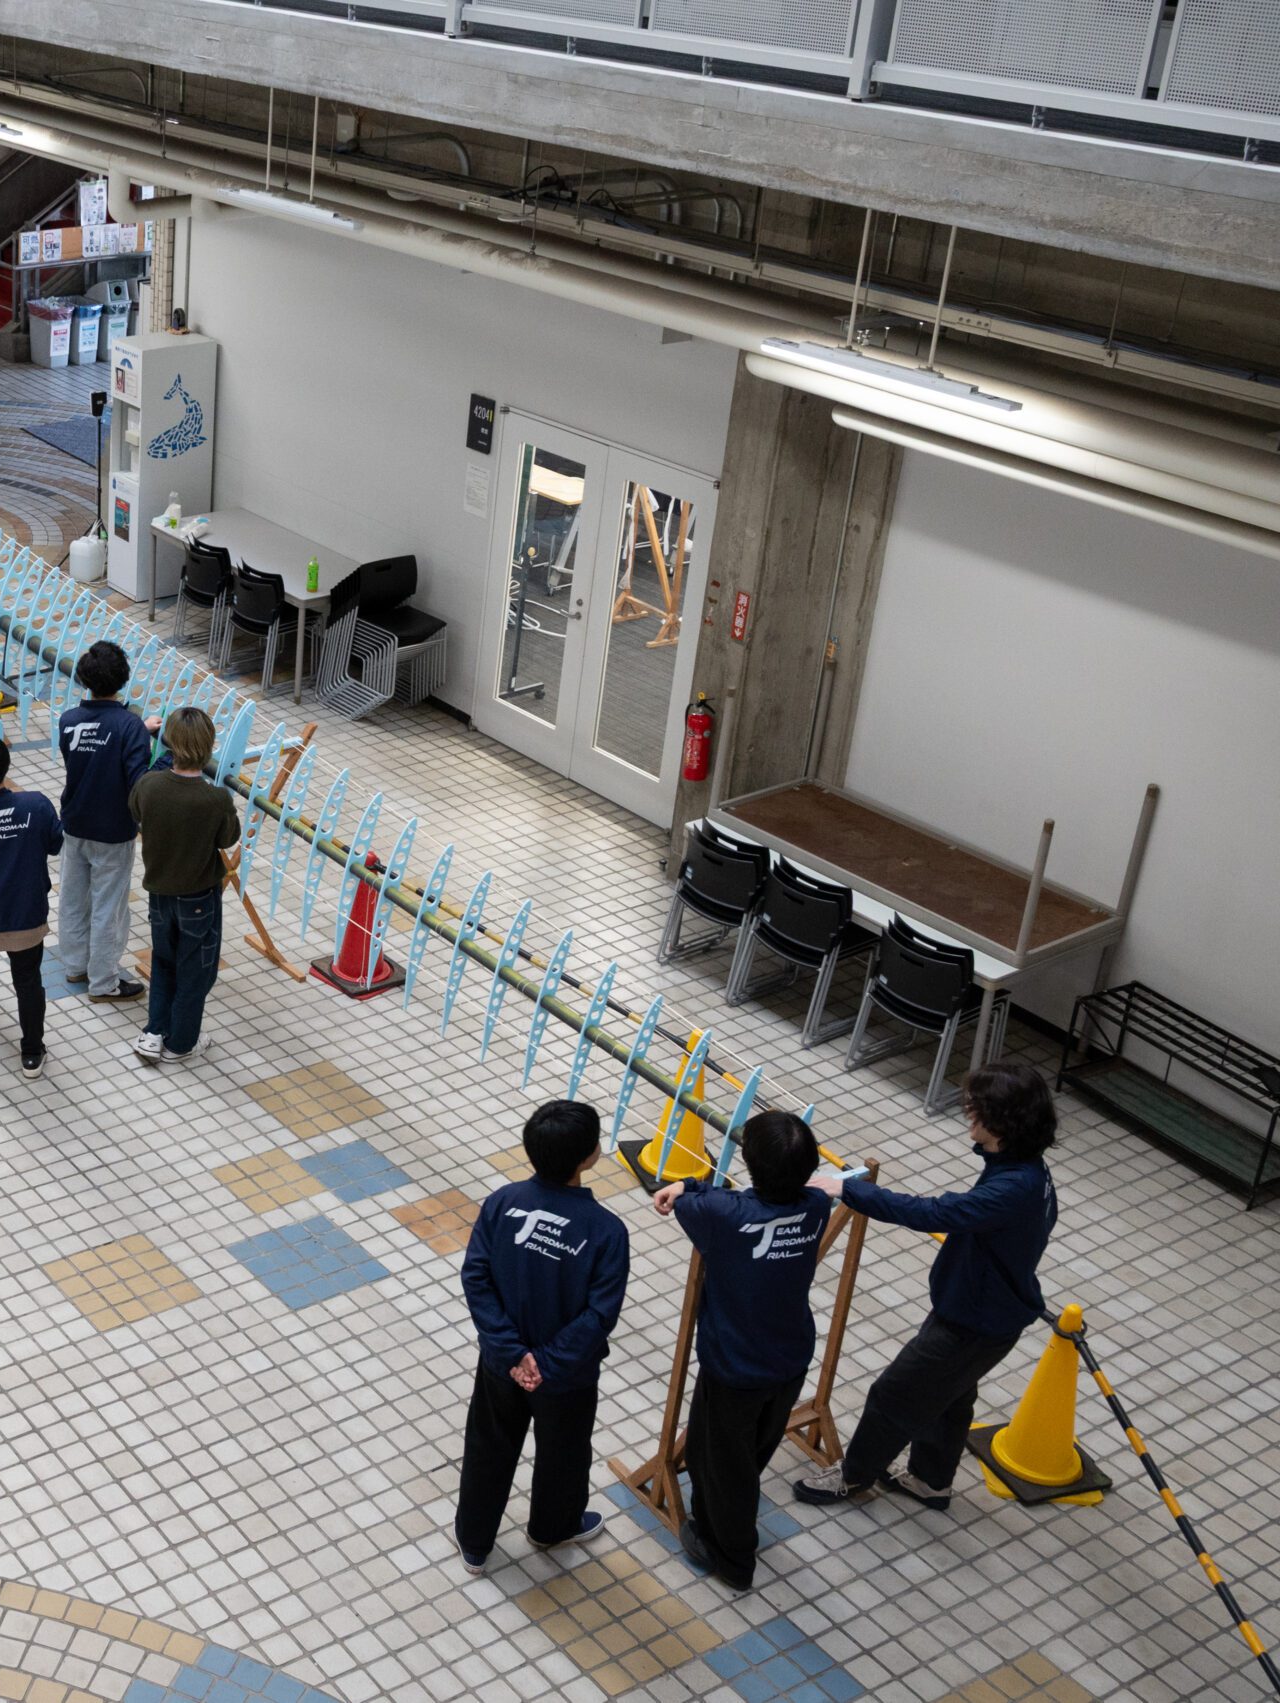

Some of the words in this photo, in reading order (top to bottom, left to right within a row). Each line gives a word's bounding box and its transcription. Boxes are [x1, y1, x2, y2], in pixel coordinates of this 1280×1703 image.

[473, 405, 490, 421] 4204
[734, 593, 749, 629] 消火器
[531, 1231, 587, 1256] BIRDMAN
[771, 1218, 823, 1248] BIRDMAN
